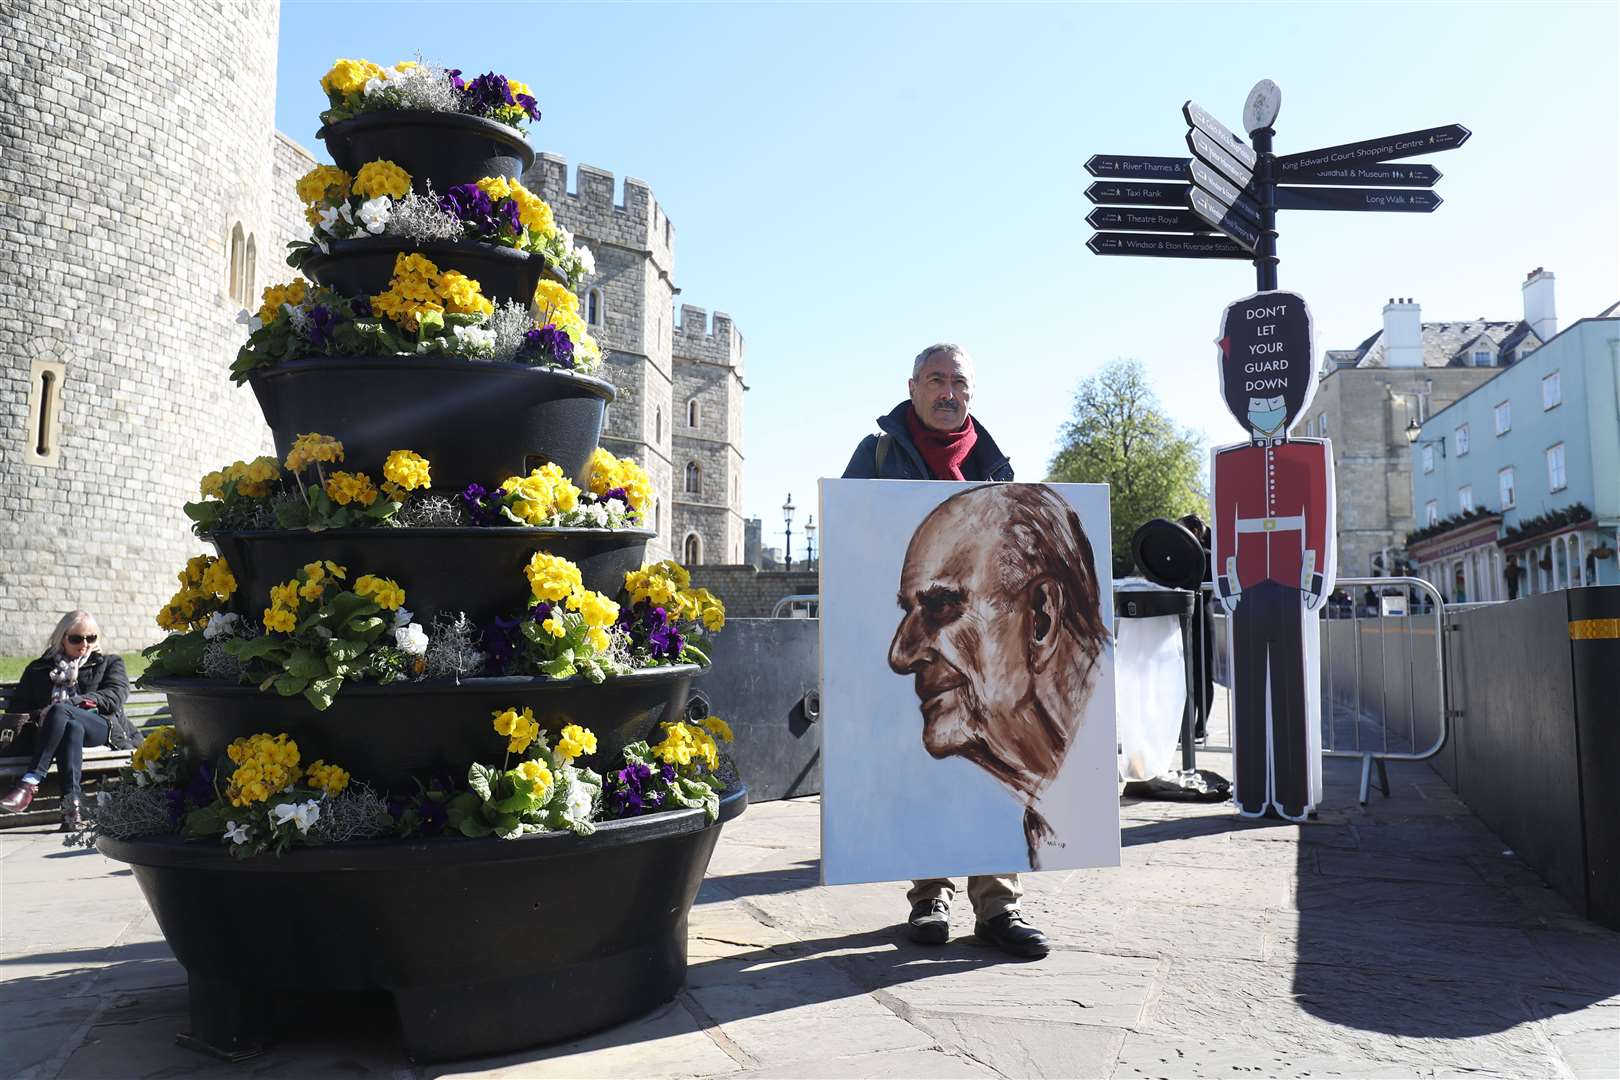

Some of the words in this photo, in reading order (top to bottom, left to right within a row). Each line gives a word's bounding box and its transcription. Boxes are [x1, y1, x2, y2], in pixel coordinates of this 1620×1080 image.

[1300, 155, 1329, 167] Edward
[1331, 151, 1355, 162] Court
[1356, 145, 1394, 157] Shopping
[1395, 139, 1424, 150] Centre
[1122, 161, 1142, 170] River
[1143, 162, 1173, 171] Thames
[1174, 163, 1181, 171] &
[1350, 169, 1356, 177] &
[1358, 169, 1390, 178] Museum
[1126, 188, 1141, 197] Taxi
[1142, 189, 1162, 197] Rank
[1366, 194, 1385, 205] Long
[1385, 195, 1406, 204] Walk
[1127, 214, 1157, 223] Theatre
[1158, 215, 1179, 225] Royal
[1126, 240, 1156, 249] Windsor
[1157, 240, 1164, 249] &
[1165, 241, 1182, 249] Eton
[1183, 242, 1214, 251] Riverside
[1215, 243, 1239, 252] Station
[1246, 305, 1286, 320] DON'T
[1257, 325, 1276, 337] LET
[1249, 342, 1284, 355] YOUR
[1244, 360, 1289, 374] GUARD
[1245, 377, 1288, 392] DOWN
